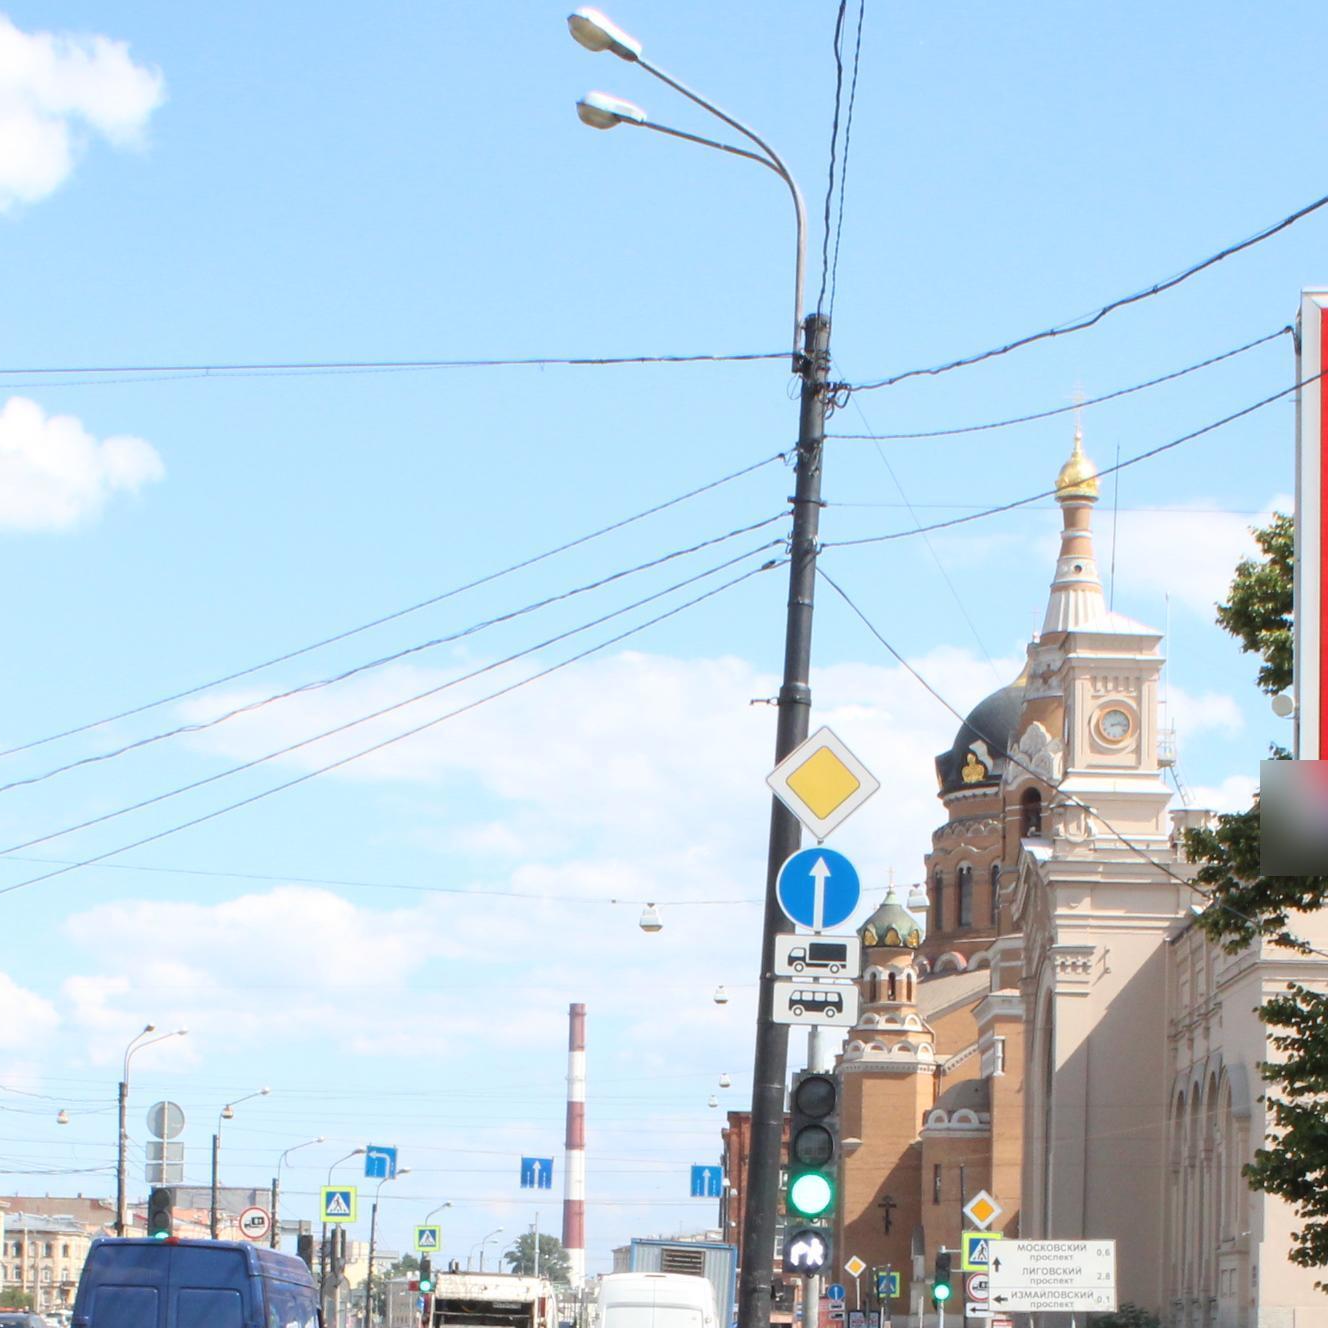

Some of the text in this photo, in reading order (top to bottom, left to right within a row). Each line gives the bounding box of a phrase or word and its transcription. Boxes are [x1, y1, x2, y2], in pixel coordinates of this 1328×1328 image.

[1017, 1243, 1087, 1252] МОСКОВСКИЙ
[1029, 1254, 1074, 1262] проспект
[1022, 1267, 1082, 1276] ЛИГОВСКИЙ
[1029, 1277, 1074, 1286] проспект
[1010, 1290, 1094, 1300] ИЗМАЙЛОВСКИЙ
[1029, 1301, 1074, 1310] проспект
